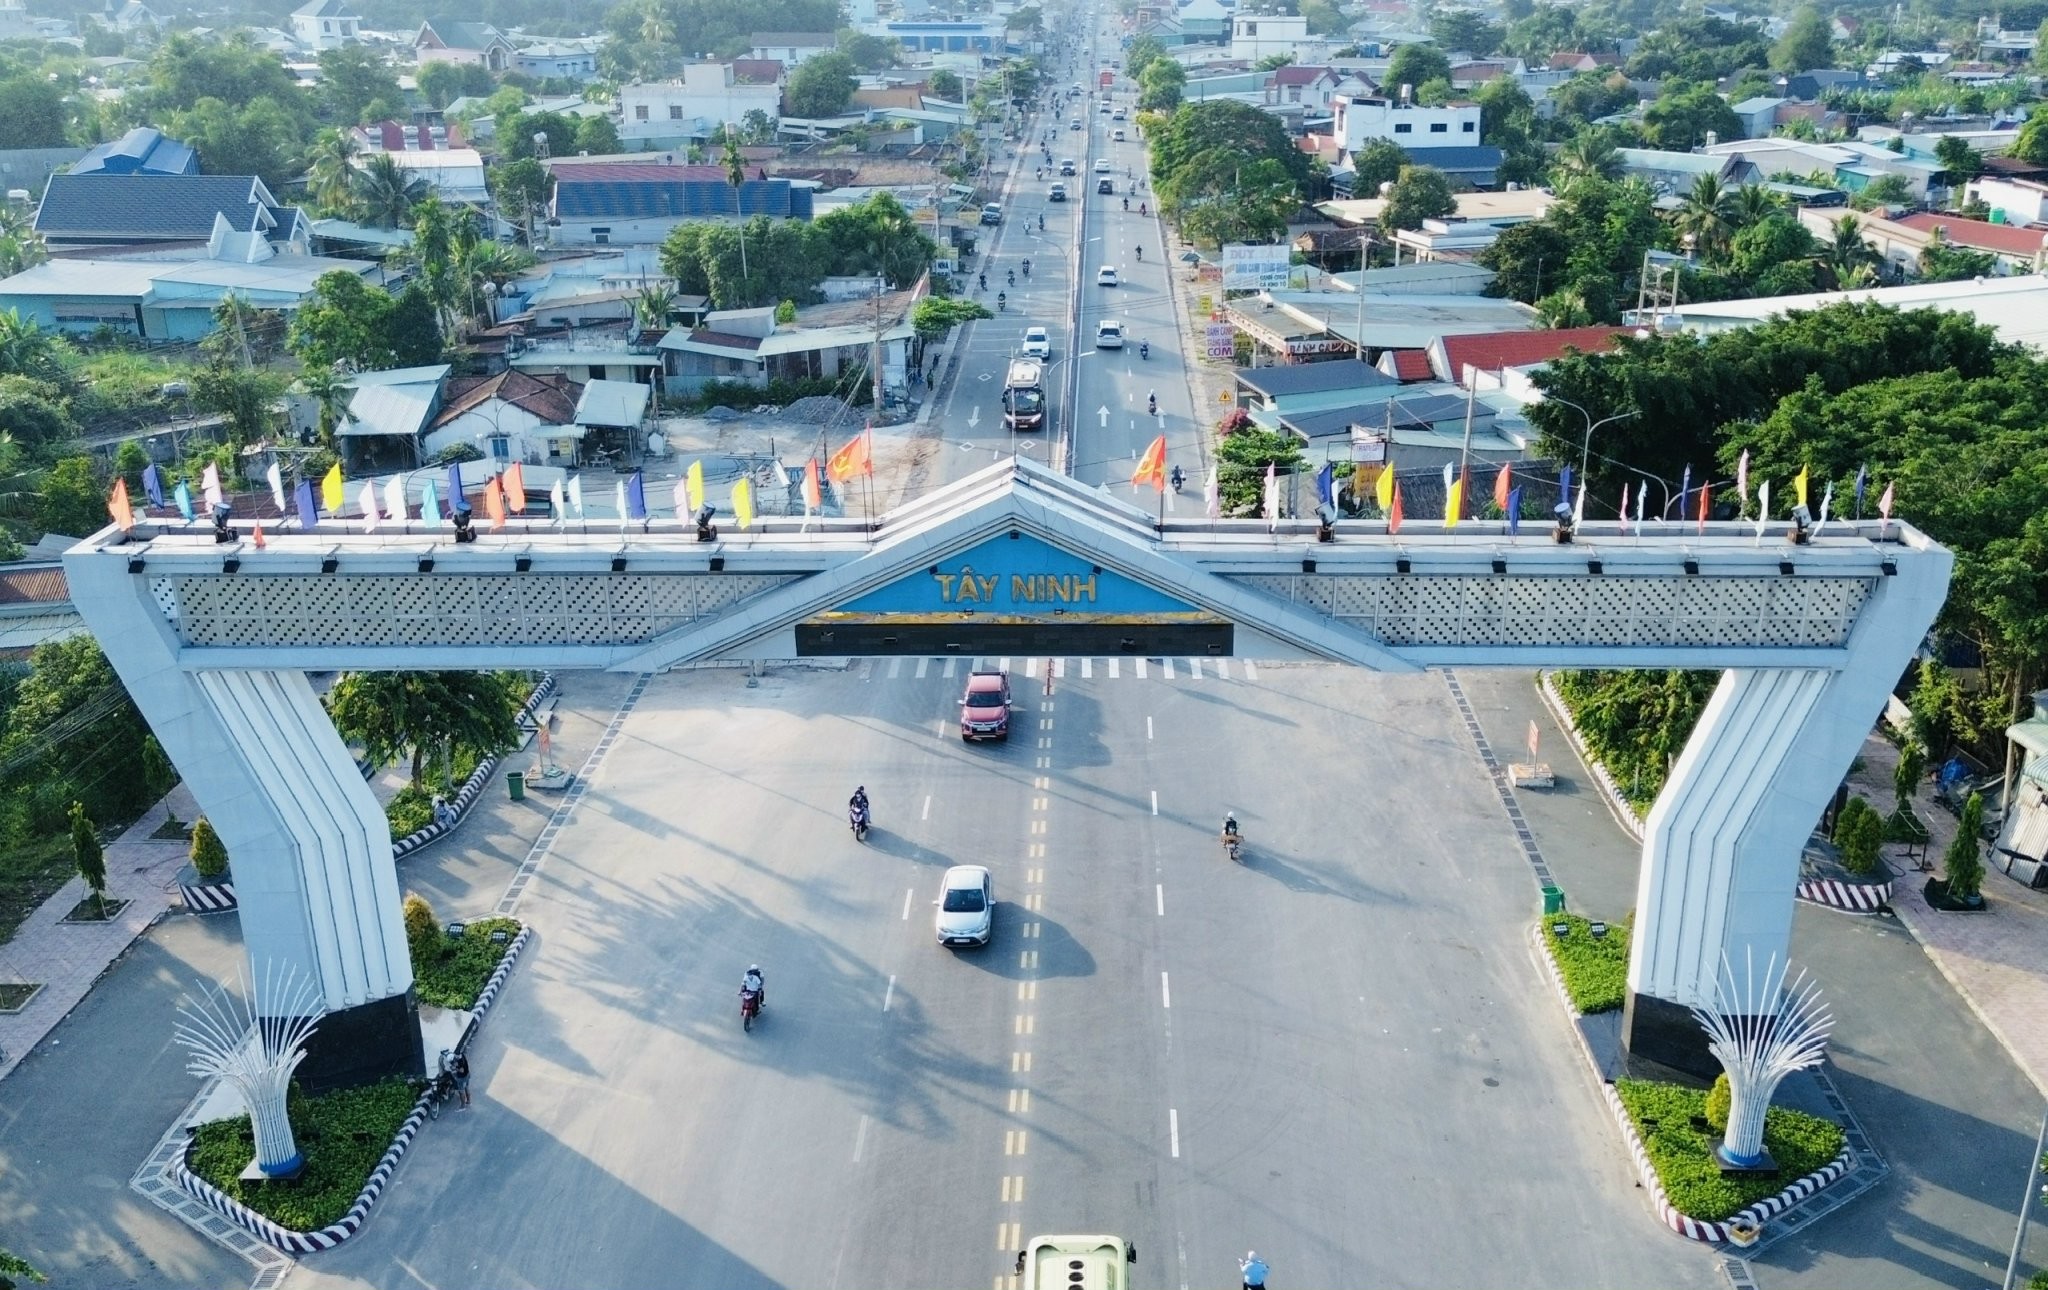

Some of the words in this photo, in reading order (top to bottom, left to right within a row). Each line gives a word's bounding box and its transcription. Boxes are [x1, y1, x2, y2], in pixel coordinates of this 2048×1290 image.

[1231, 249, 1255, 259] DUY
[934, 566, 999, 602] TÂY
[1012, 574, 1096, 602] NINH
